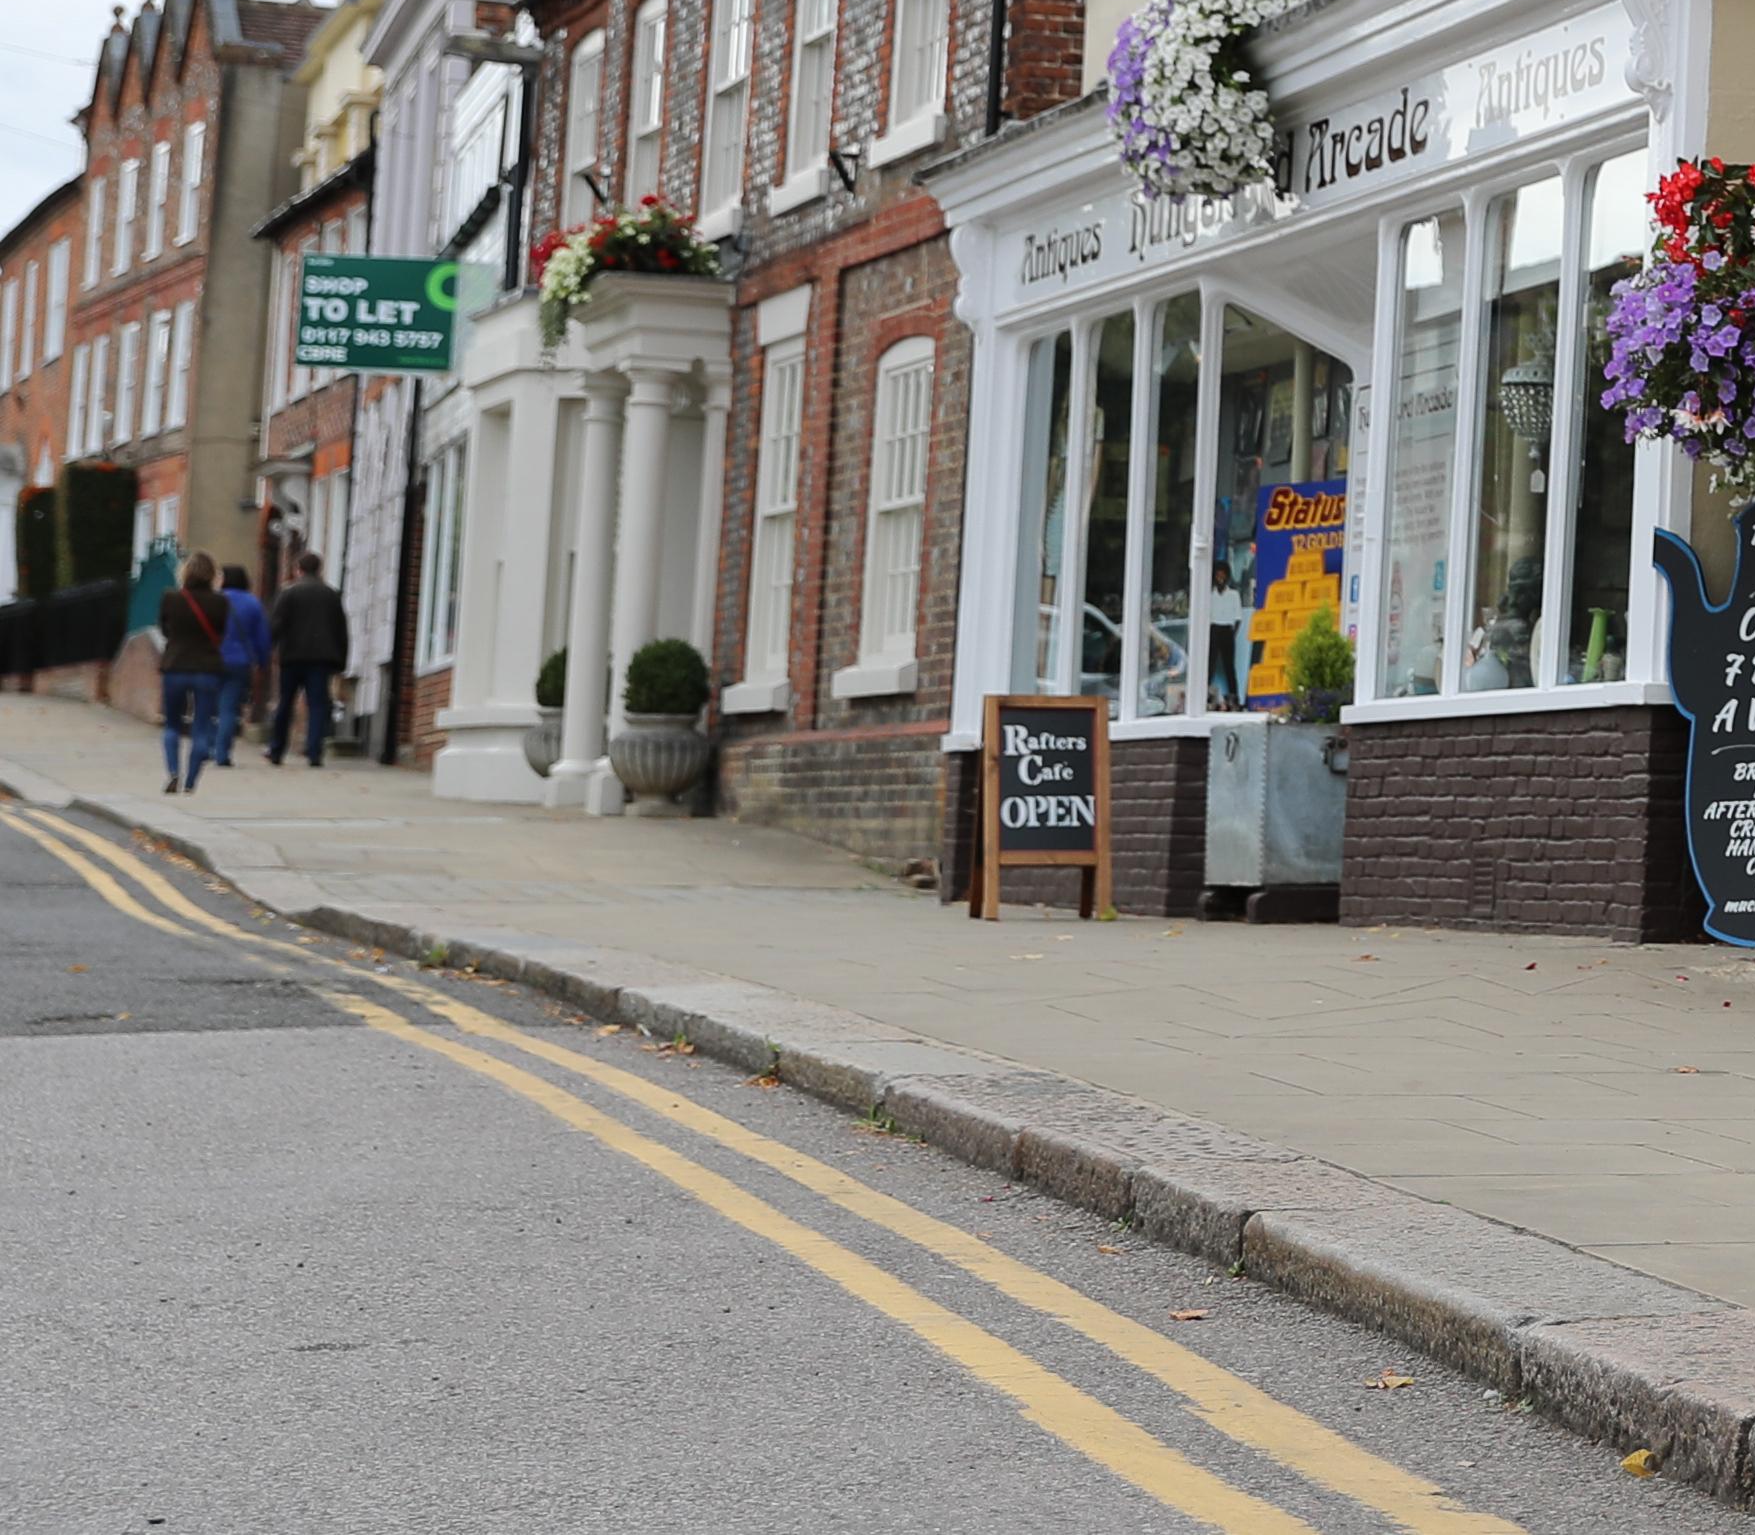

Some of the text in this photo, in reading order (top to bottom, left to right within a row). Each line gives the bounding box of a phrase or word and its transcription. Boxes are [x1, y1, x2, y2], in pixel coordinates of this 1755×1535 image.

[1021, 223, 1103, 285] Antiques
[1304, 81, 1430, 194] Arcade
[1475, 34, 1605, 124] Antiques
[305, 275, 368, 295] SHOP
[303, 297, 420, 325] TO LET
[301, 326, 351, 344] 0117
[1265, 486, 1346, 531] Status
[1725, 653, 1745, 687] 7
[1712, 698, 1739, 733] A
[1003, 725, 1087, 756] Rafters
[1017, 755, 1074, 785] Café
[1000, 795, 1095, 828] OPEN
